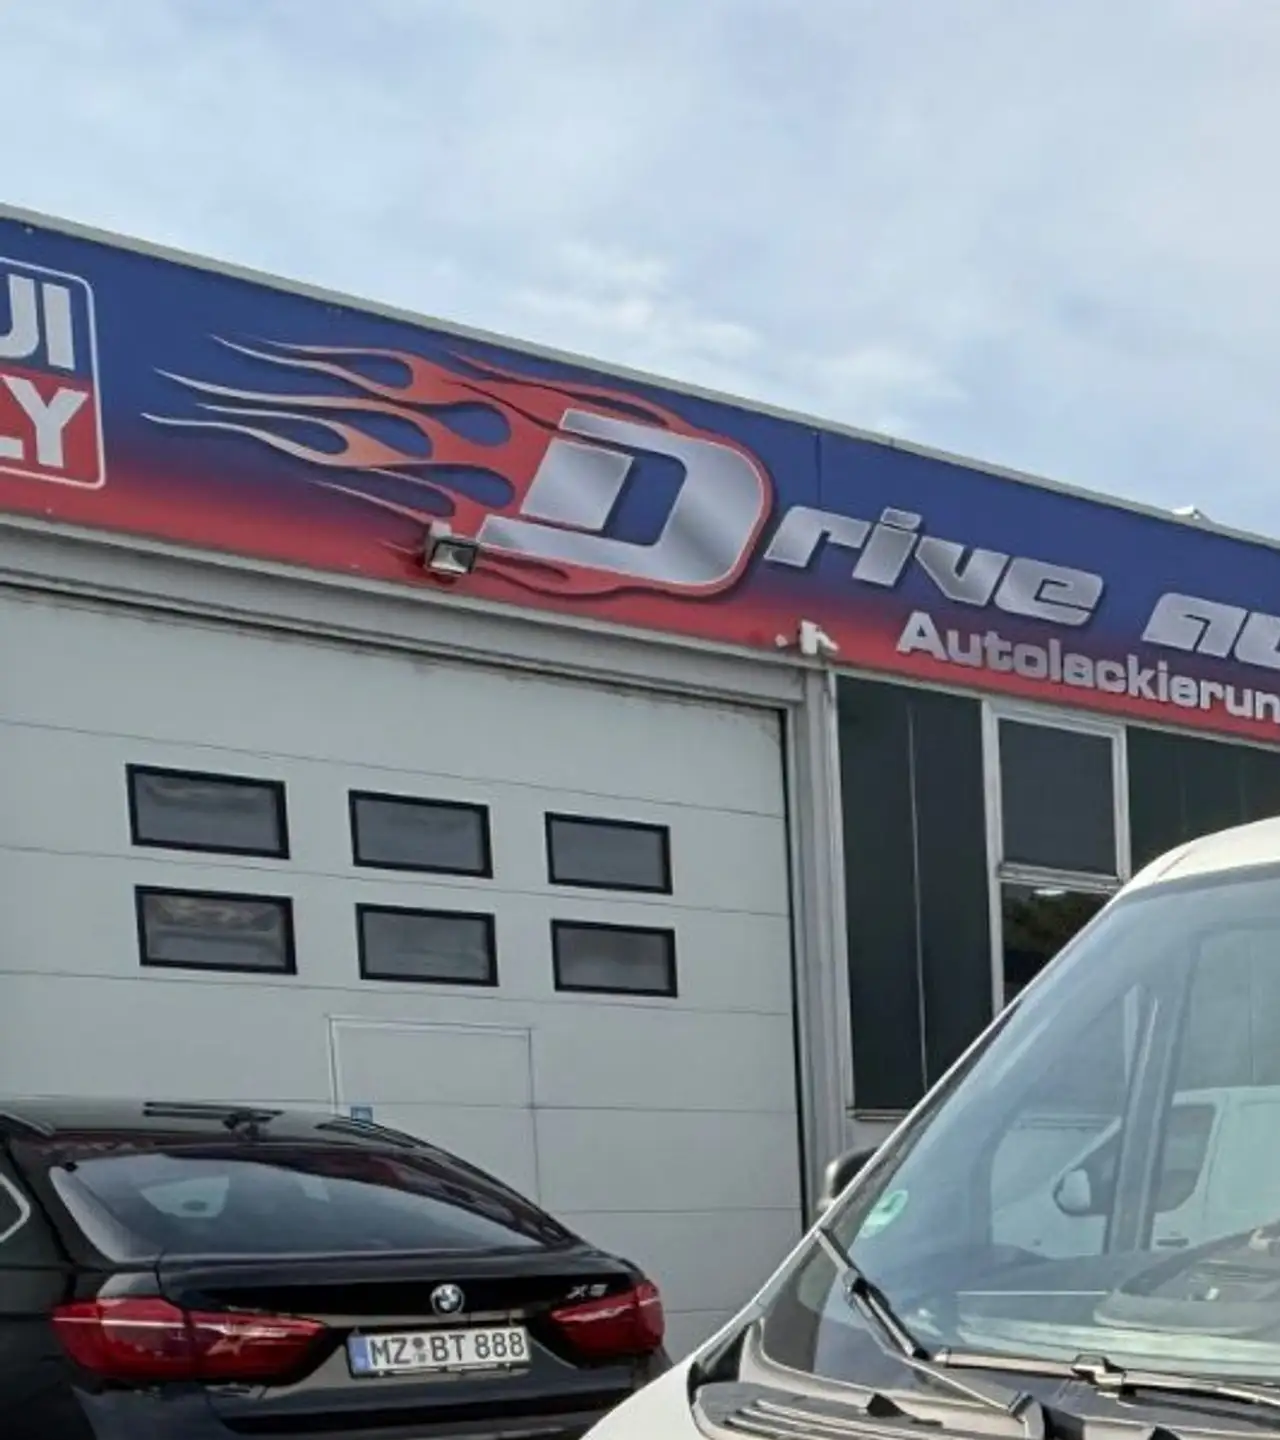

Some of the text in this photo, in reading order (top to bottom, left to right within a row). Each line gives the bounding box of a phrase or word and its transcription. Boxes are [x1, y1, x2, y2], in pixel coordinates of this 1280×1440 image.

[475, 408, 1105, 627] Drive
[369, 1331, 526, 1366] MZ BT 888
